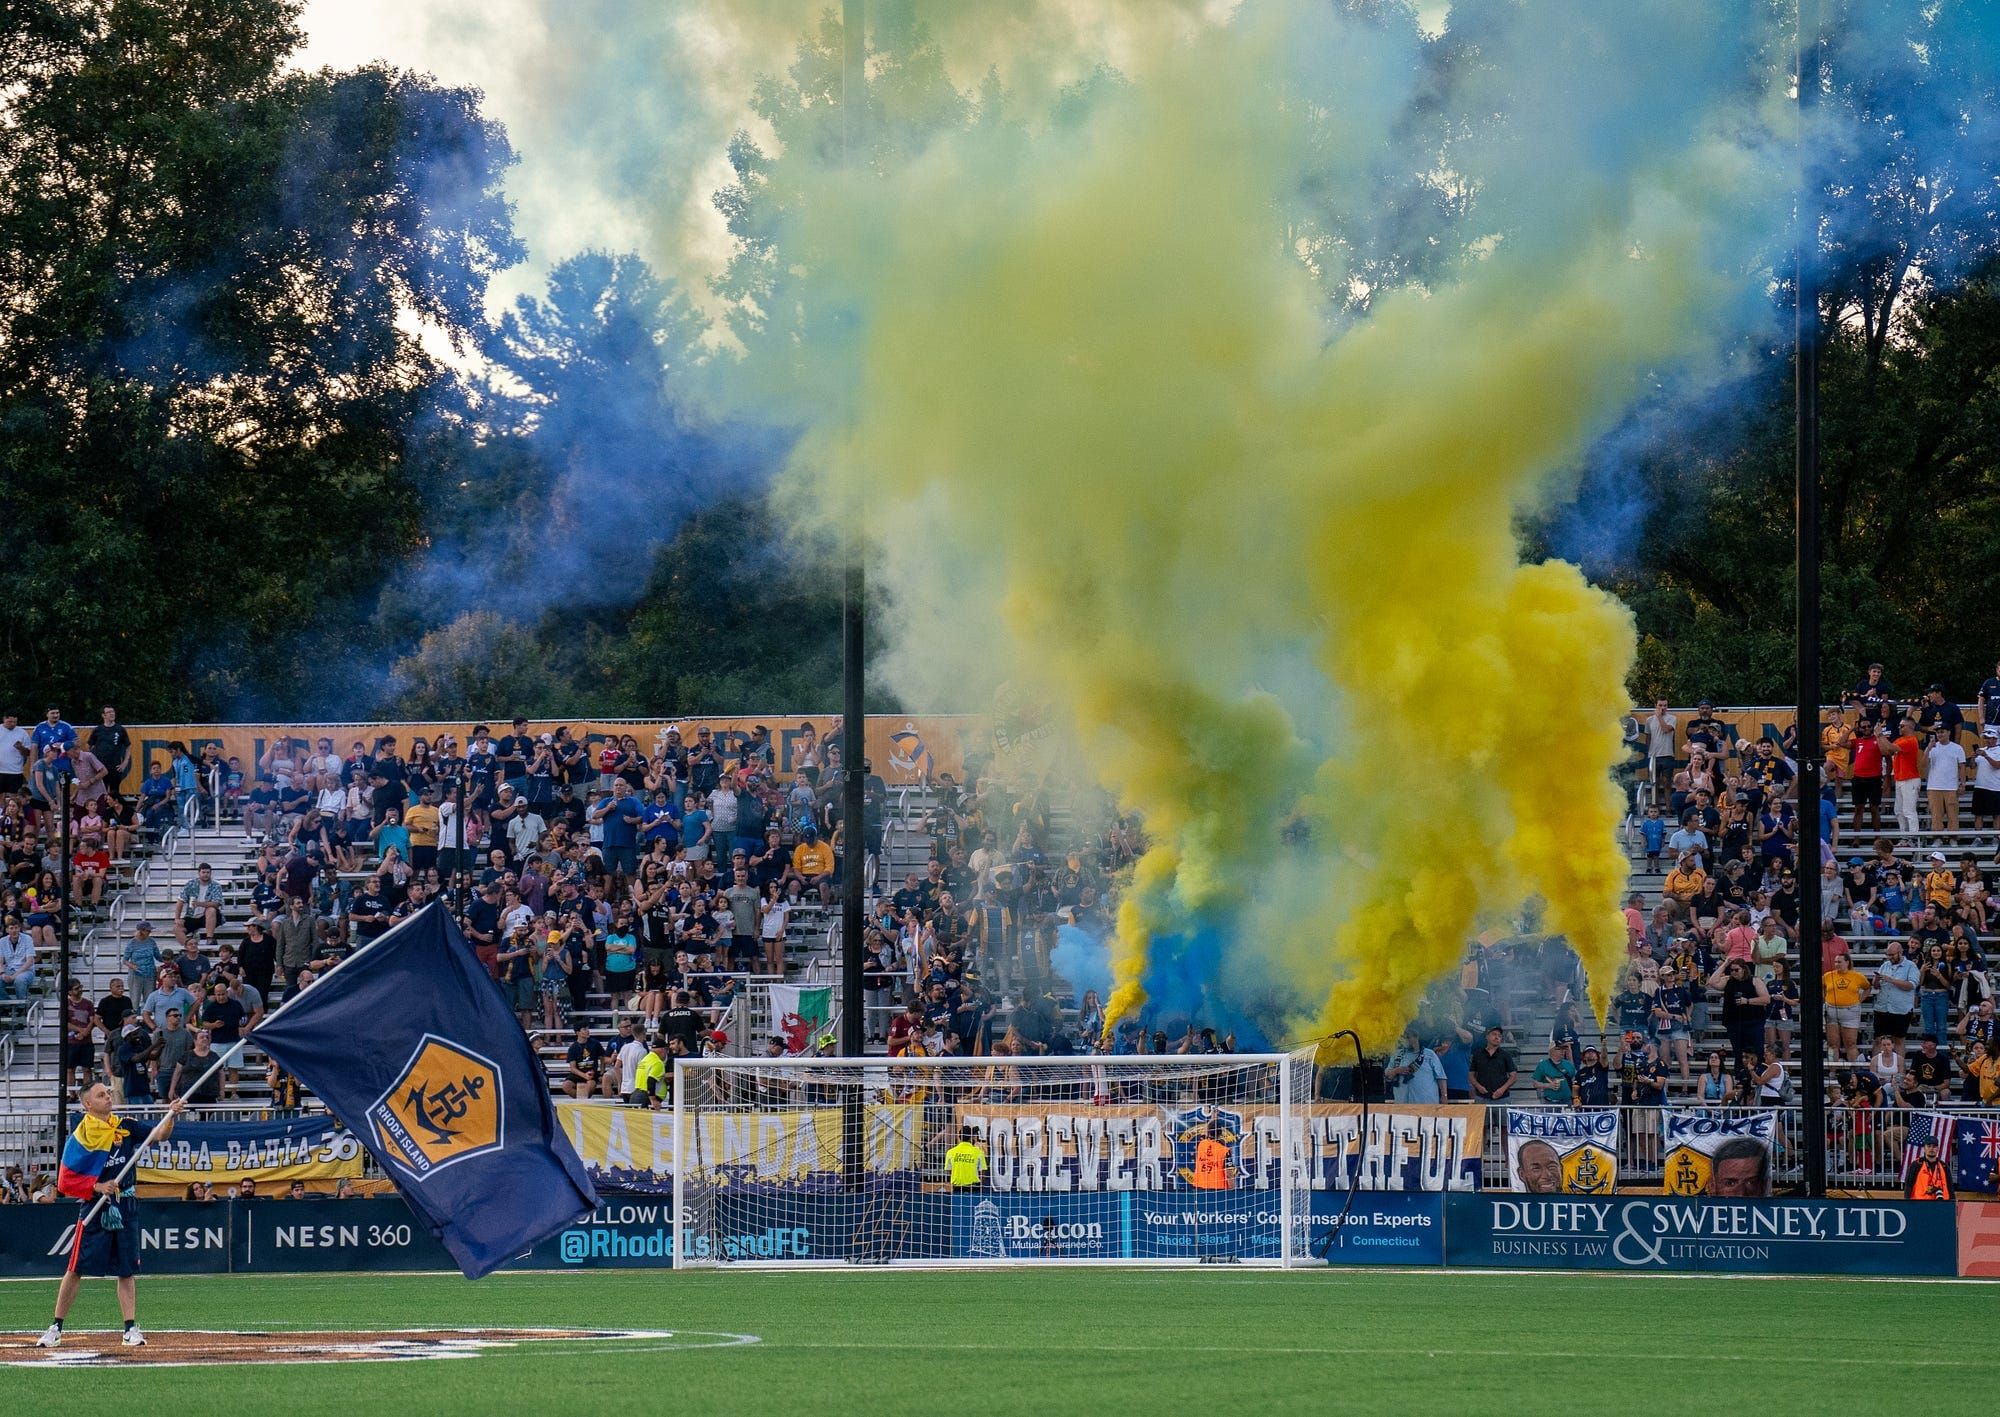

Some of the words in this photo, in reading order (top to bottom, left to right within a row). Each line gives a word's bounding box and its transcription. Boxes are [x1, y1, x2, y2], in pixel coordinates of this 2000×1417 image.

[1508, 1111, 1618, 1137] KHANO
[1668, 1113, 1773, 1138] KOKE
[136, 1140, 213, 1171] ARRA
[225, 1125, 312, 1171] BAHÍA
[318, 1128, 359, 1163] 36
[376, 1104, 404, 1138] RHODE
[399, 1135, 430, 1171] ISLAND
[386, 1141, 397, 1152] FC
[652, 1112, 821, 1180] BANDA
[1254, 1113, 1475, 1191] FAITHFUL
[577, 1206, 658, 1224] LLOW
[1143, 1212, 1178, 1226] Your
[1256, 1211, 1367, 1228] Copensaion
[1373, 1212, 1432, 1229] Experts
[275, 1225, 359, 1248] NESN
[366, 1224, 411, 1248] 360
[1003, 1217, 1012, 1237] The
[1491, 1201, 1614, 1232] DUFFY
[1612, 1200, 1668, 1265] &
[1652, 1204, 1827, 1240] SWEENEY,
[1835, 1207, 1907, 1237] LTD
[140, 1227, 224, 1250] NESN
[1012, 1241, 1042, 1249] Mutual
[1089, 1239, 1104, 1249] Co.
[1156, 1234, 1192, 1245] Rhode
[1352, 1235, 1420, 1246] Connecticut
[1493, 1241, 1567, 1256] BUSINESS
[1573, 1242, 1607, 1257] LAW
[1671, 1245, 1769, 1260] LITIGATION
